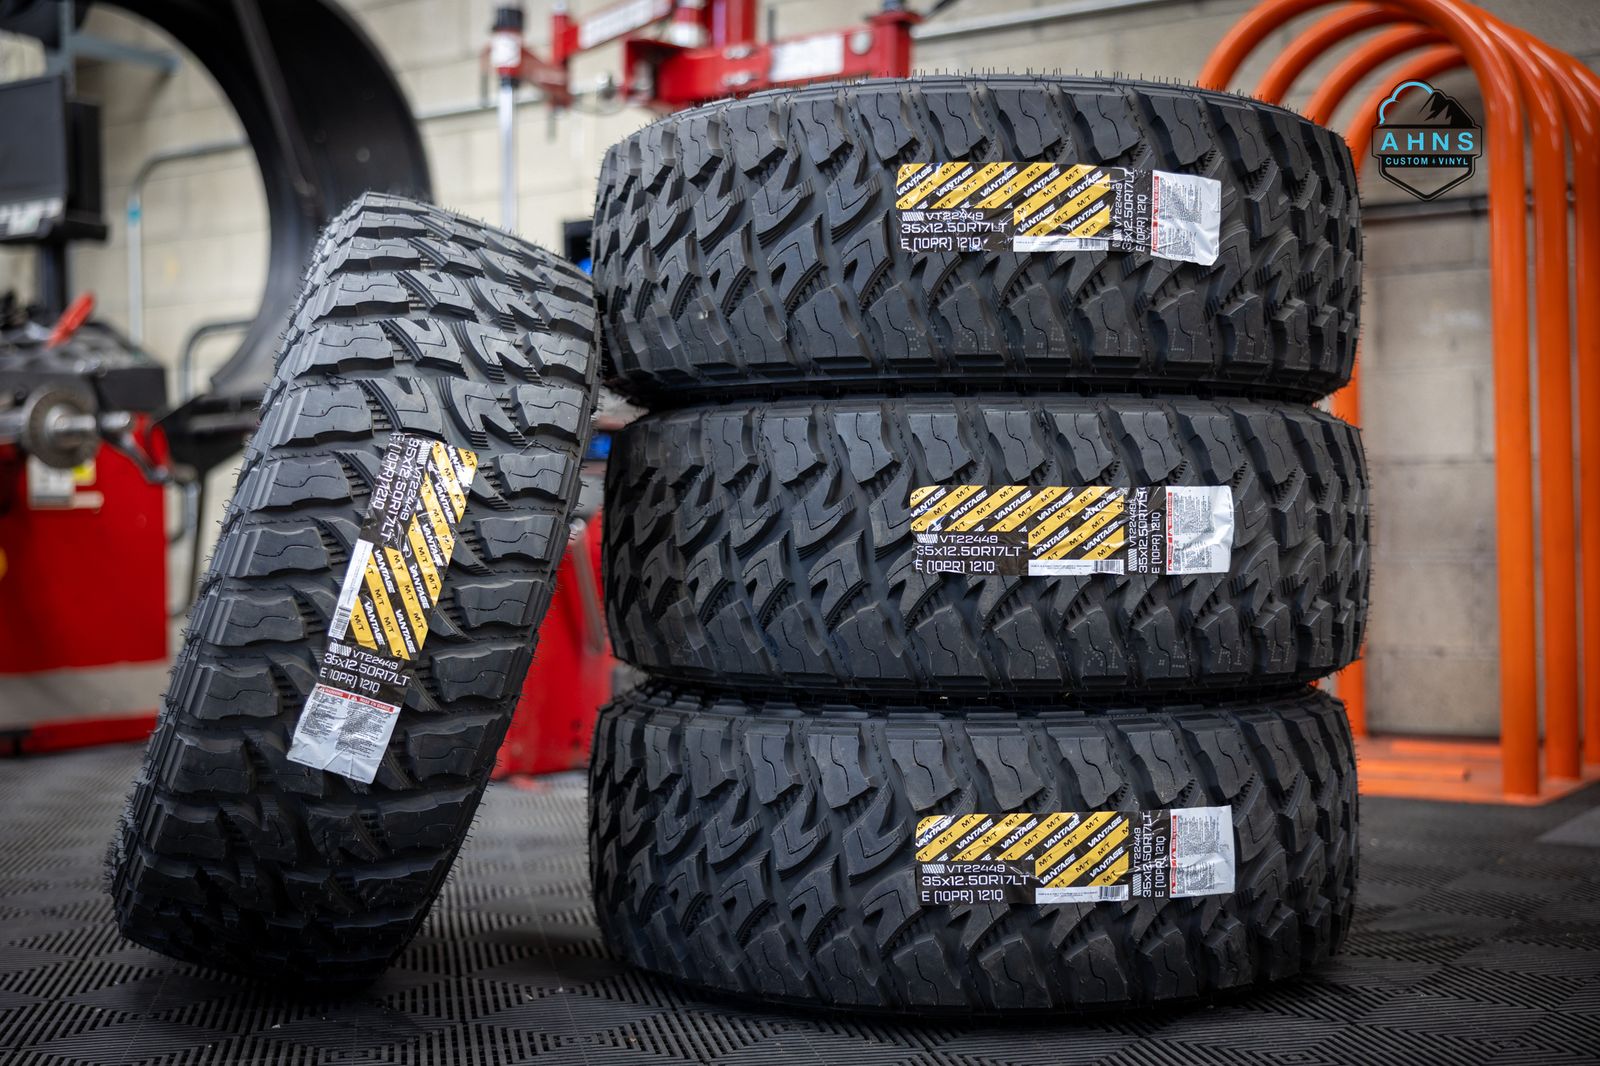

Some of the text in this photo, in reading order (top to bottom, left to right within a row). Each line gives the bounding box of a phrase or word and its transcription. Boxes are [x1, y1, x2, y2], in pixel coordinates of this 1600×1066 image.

[936, 166, 974, 197] VANTAGE
[980, 166, 1018, 197] VANTAGE
[1023, 167, 1060, 197] VANTAGE
[926, 211, 984, 220] VT22449
[1018, 203, 1056, 233] VANTAGE
[1067, 200, 1105, 231] VANTAGE
[901, 238, 909, 249] E
[911, 488, 946, 517] VANTAGE
[950, 490, 987, 520] VANTAGE
[994, 490, 1032, 520] VANTAGE
[1037, 492, 1074, 520] VANTAGE
[422, 524, 444, 566] VANTAGE
[940, 535, 998, 543] VT22449
[1033, 526, 1070, 557] VANTAGE
[1082, 520, 1119, 551] VANTAGE
[374, 550, 395, 593] VANTAGE
[915, 560, 923, 571] E
[970, 560, 995, 573] 121Q
[1151, 566, 1160, 574] E
[409, 565, 430, 609] VANTAGE
[364, 602, 385, 645] VANTAGE
[395, 609, 416, 653] VANTAGE
[320, 667, 327, 677] E
[324, 653, 410, 686] 35x12.50R17LT
[353, 650, 398, 670] VT22449
[956, 818, 993, 849] VANTAGE
[1001, 818, 1038, 849] VANTAGE
[1044, 818, 1080, 848] VANTAGE
[1087, 816, 1122, 847] VANTAGE
[1155, 836, 1166, 855] 121Q
[1089, 847, 1124, 877] VANTAGE
[1133, 827, 1141, 872] VT22449
[922, 875, 1029, 886] 35x12.50R17LT
[946, 864, 1005, 873] VT22449
[1040, 853, 1076, 885] VANTAGE
[922, 891, 930, 902] E
[977, 890, 1003, 902] 121Q
[1155, 889, 1164, 897] E
